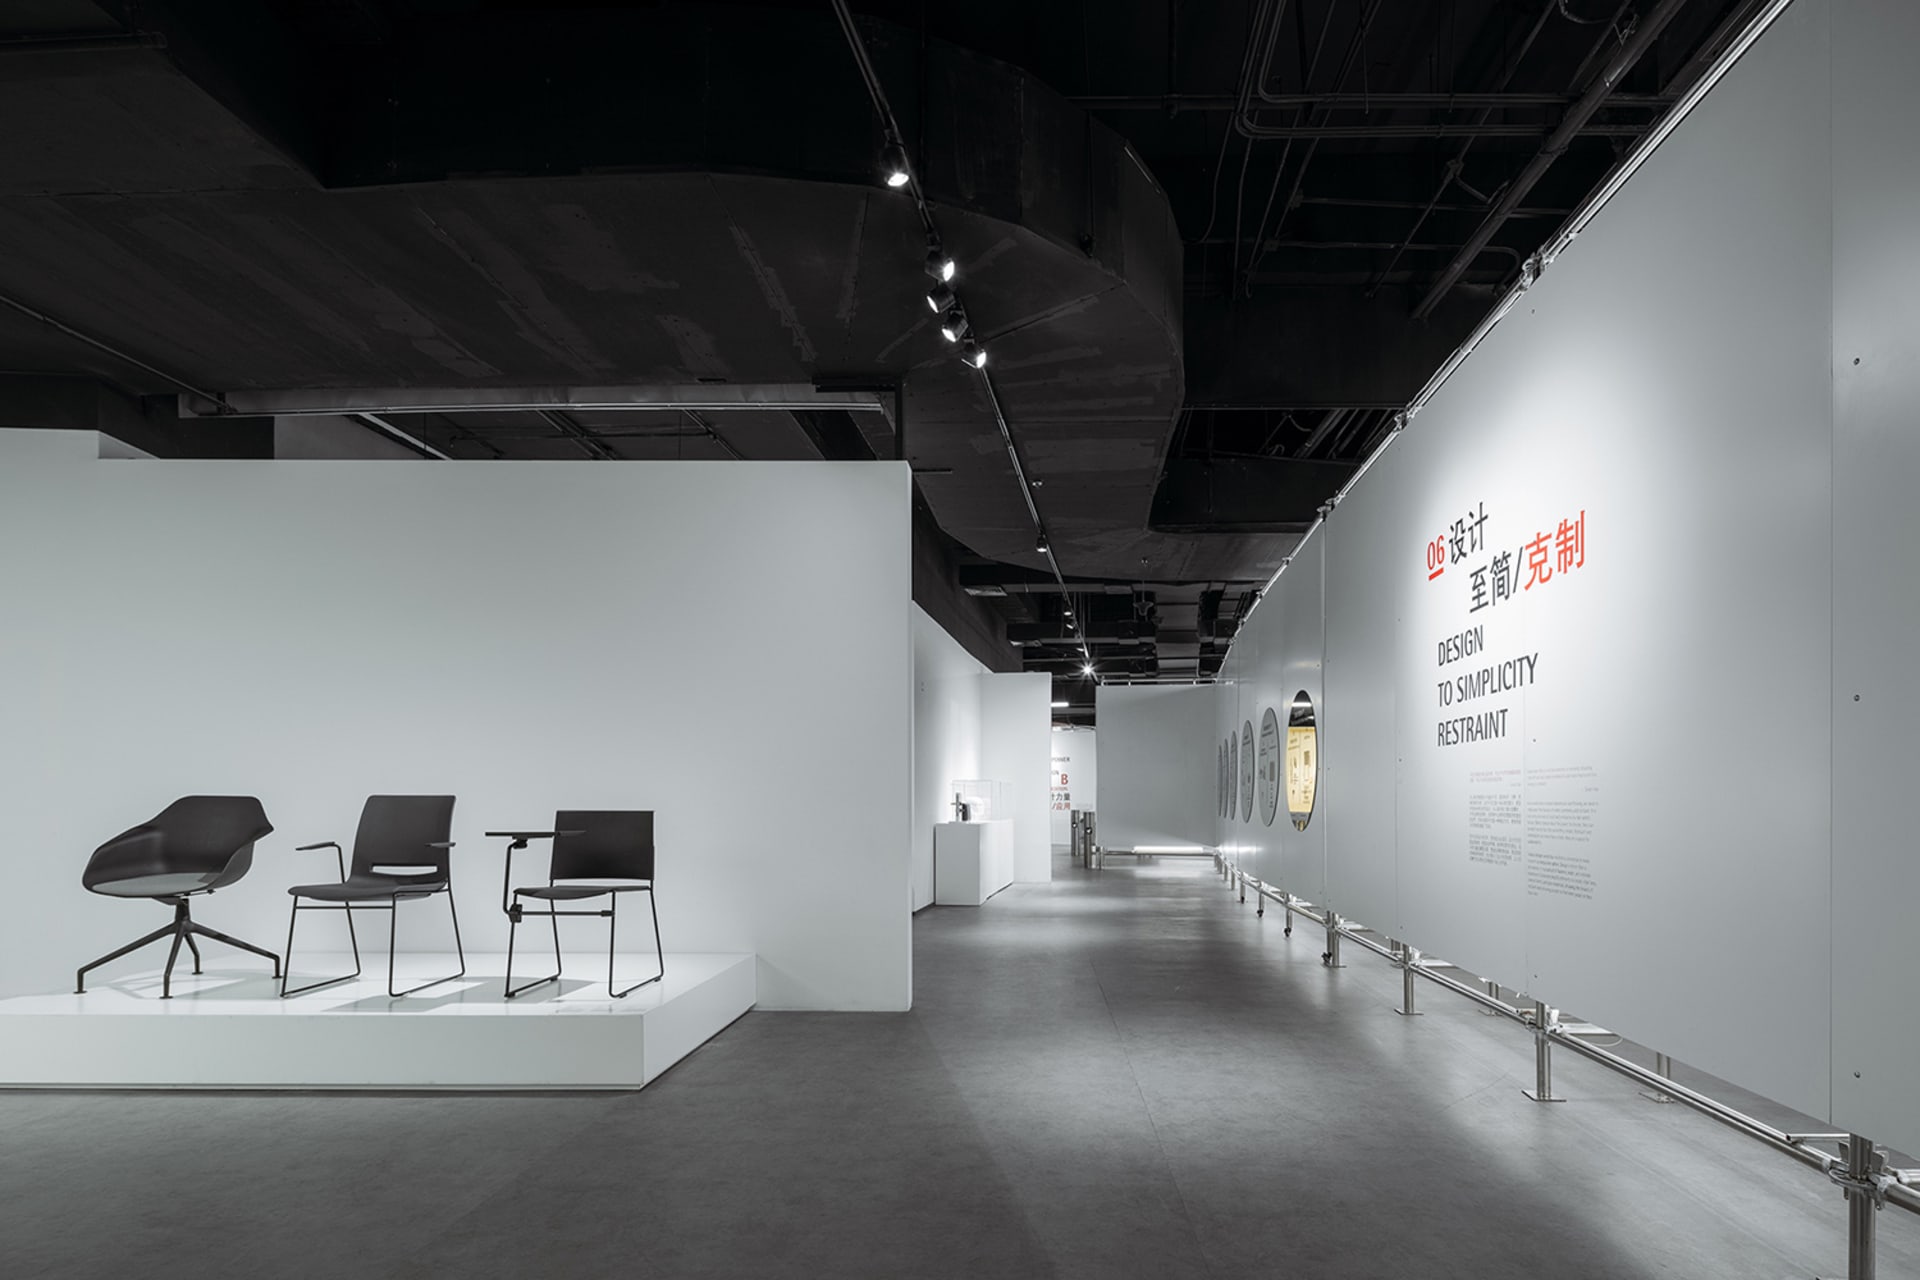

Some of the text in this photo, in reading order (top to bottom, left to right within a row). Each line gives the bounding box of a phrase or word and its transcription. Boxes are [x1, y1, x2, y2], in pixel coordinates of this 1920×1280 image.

[1427, 501, 1489, 571] 06 设计
[1470, 509, 1585, 613] 至简/克制
[1438, 624, 1484, 667] DESIGN
[1437, 652, 1539, 708] TO SIMPLICITY
[1437, 708, 1508, 747] RESTRAINT
[1061, 773, 1069, 785] B
